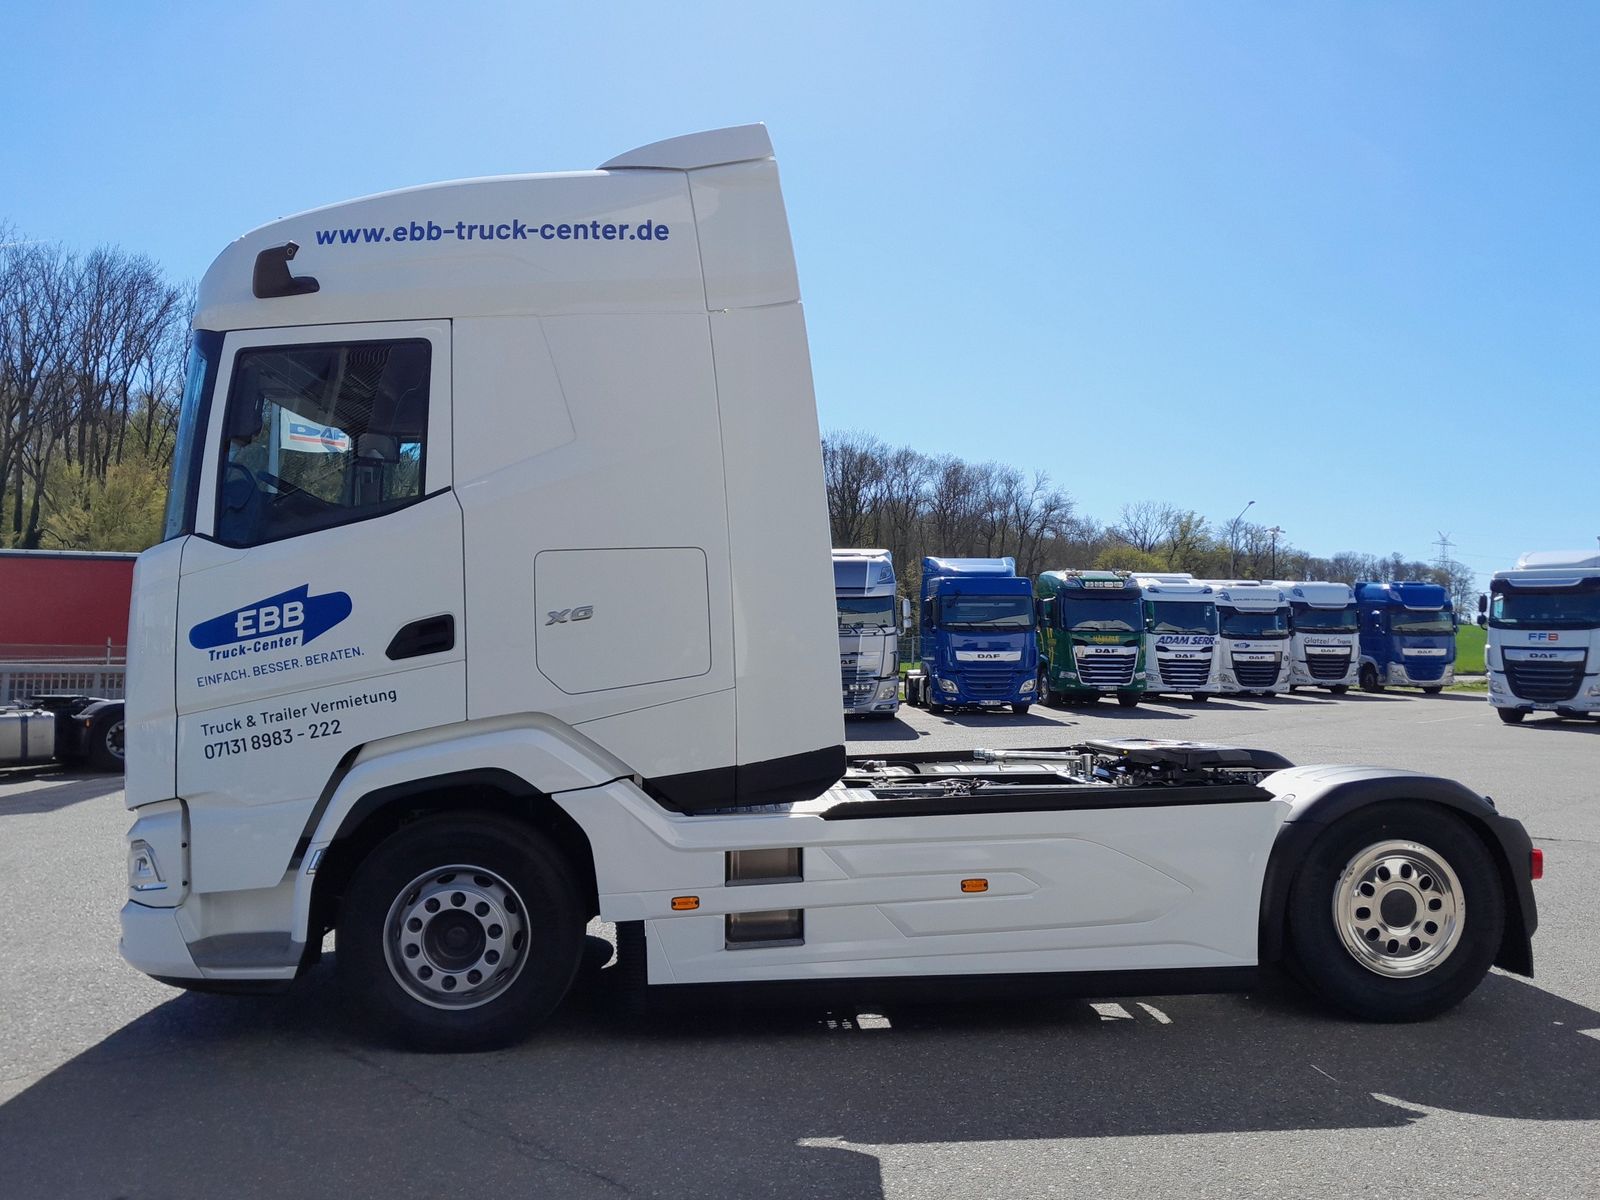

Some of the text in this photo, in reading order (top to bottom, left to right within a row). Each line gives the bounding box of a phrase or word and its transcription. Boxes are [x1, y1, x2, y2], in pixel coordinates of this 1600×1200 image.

[315, 219, 670, 245] www.ebb-truck-center.de
[289, 422, 346, 441] DAF
[235, 600, 305, 638] EBB
[545, 604, 594, 627] XG
[208, 635, 299, 662] Truck-Center
[1156, 635, 1190, 645] ADAM
[1528, 632, 1559, 641] FFB
[196, 646, 365, 688] EINFACH. BESSER. BERATEN.
[201, 689, 398, 737] Truck & Trailer Vermietung
[204, 737, 248, 760] 07131
[251, 728, 294, 751] 8983
[308, 719, 343, 740] 222
